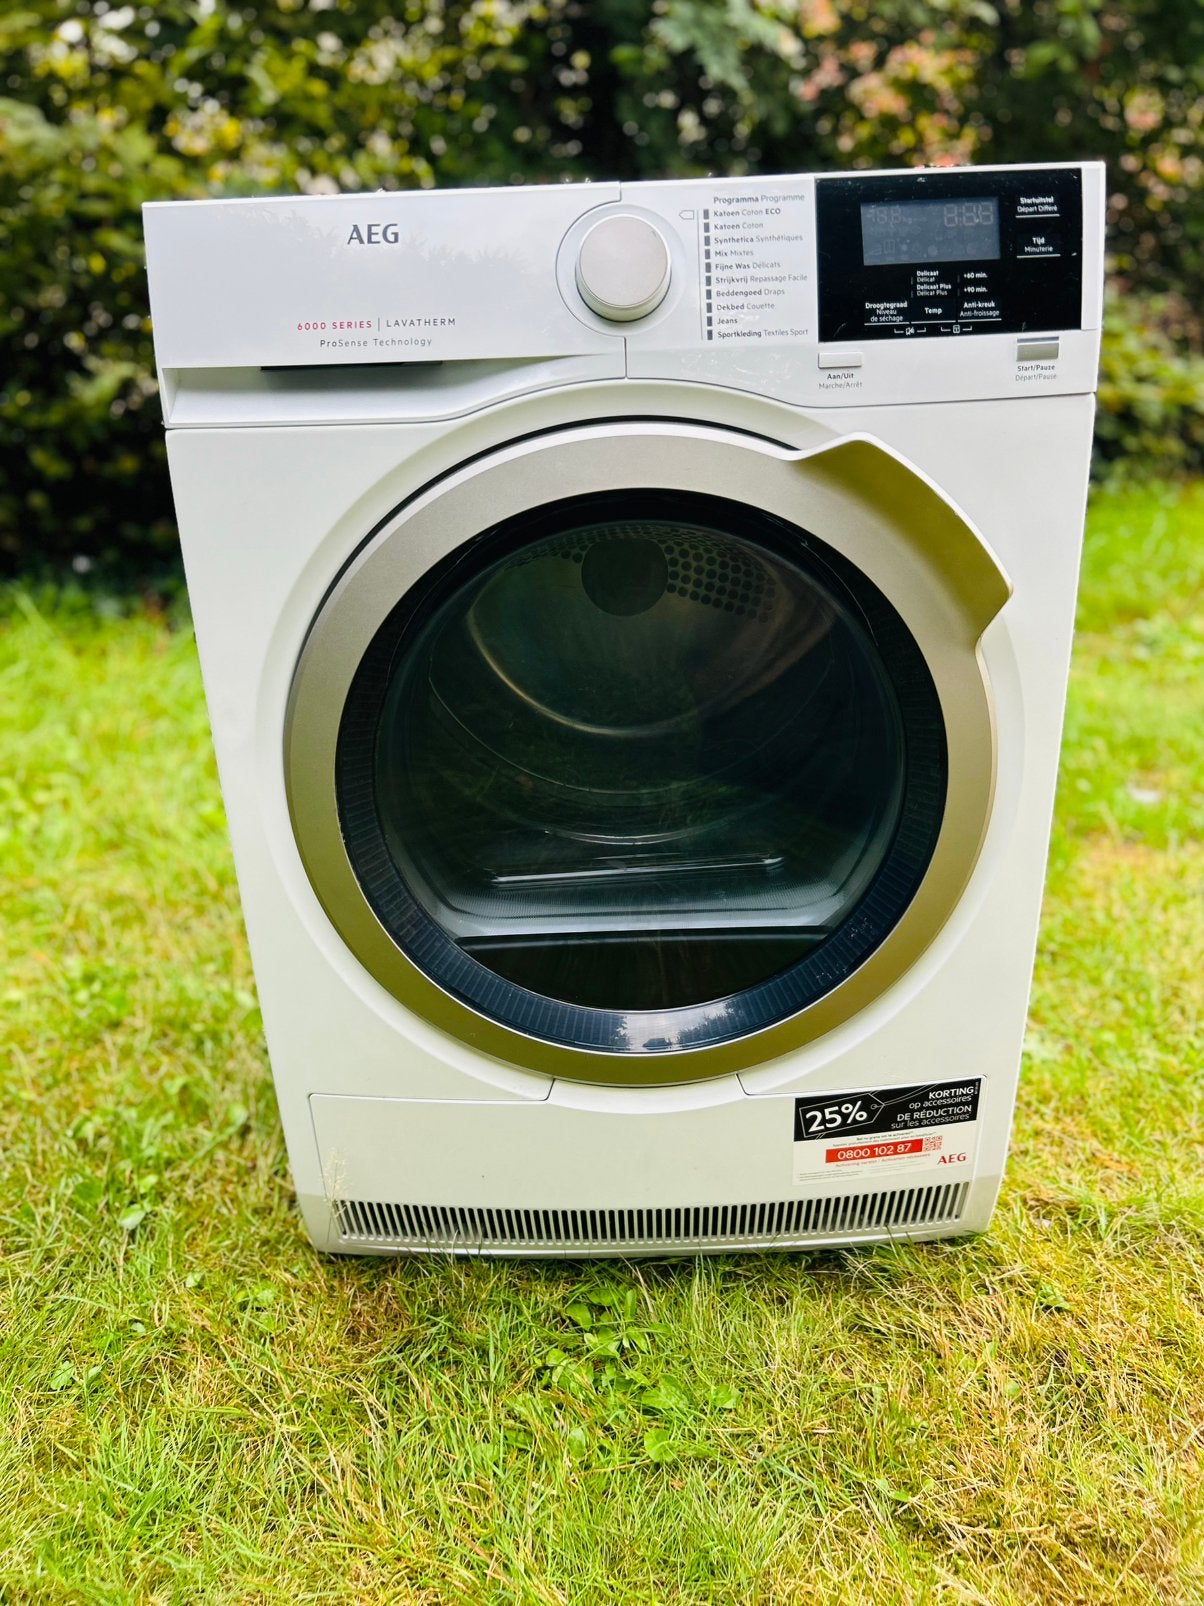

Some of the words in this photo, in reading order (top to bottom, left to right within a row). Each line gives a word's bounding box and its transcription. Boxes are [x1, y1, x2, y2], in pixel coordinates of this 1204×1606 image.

[714, 196, 759, 205] Programma
[760, 194, 805, 203] Programme
[347, 224, 399, 245] AEG
[714, 236, 754, 245] Synthetica
[756, 234, 803, 243] Synthétiques
[1032, 237, 1045, 245] Tijd
[715, 263, 733, 271] Fijne
[752, 261, 781, 269] Délicats
[716, 276, 749, 284] Strijkvrij
[750, 275, 787, 283] Repassage
[716, 289, 762, 298] Beddengoed
[764, 288, 786, 296] Draps
[717, 303, 745, 311] Dekbed
[746, 302, 775, 310] Couette
[865, 301, 908, 310] Droogtegraad
[297, 322, 326, 331] 6000
[332, 320, 372, 330] SERIES
[386, 318, 456, 328] LAVATHERM
[717, 317, 738, 325] Jeans
[718, 329, 762, 339] Sportkleding
[764, 329, 789, 337] Textiles
[790, 328, 809, 336] Sport
[320, 338, 368, 347] ProSense
[373, 337, 432, 347] Technology
[928, 1086, 974, 1100] KORTING
[908, 1102, 921, 1110] op
[805, 1100, 868, 1133] 25%
[897, 1112, 911, 1121] DE
[913, 1105, 972, 1119] RÉDUCTION
[891, 1122, 905, 1130] sur
[837, 1148, 871, 1160] 0800
[873, 1145, 894, 1156] 102
[896, 1143, 912, 1153] 87
[937, 1152, 967, 1165] AEG
